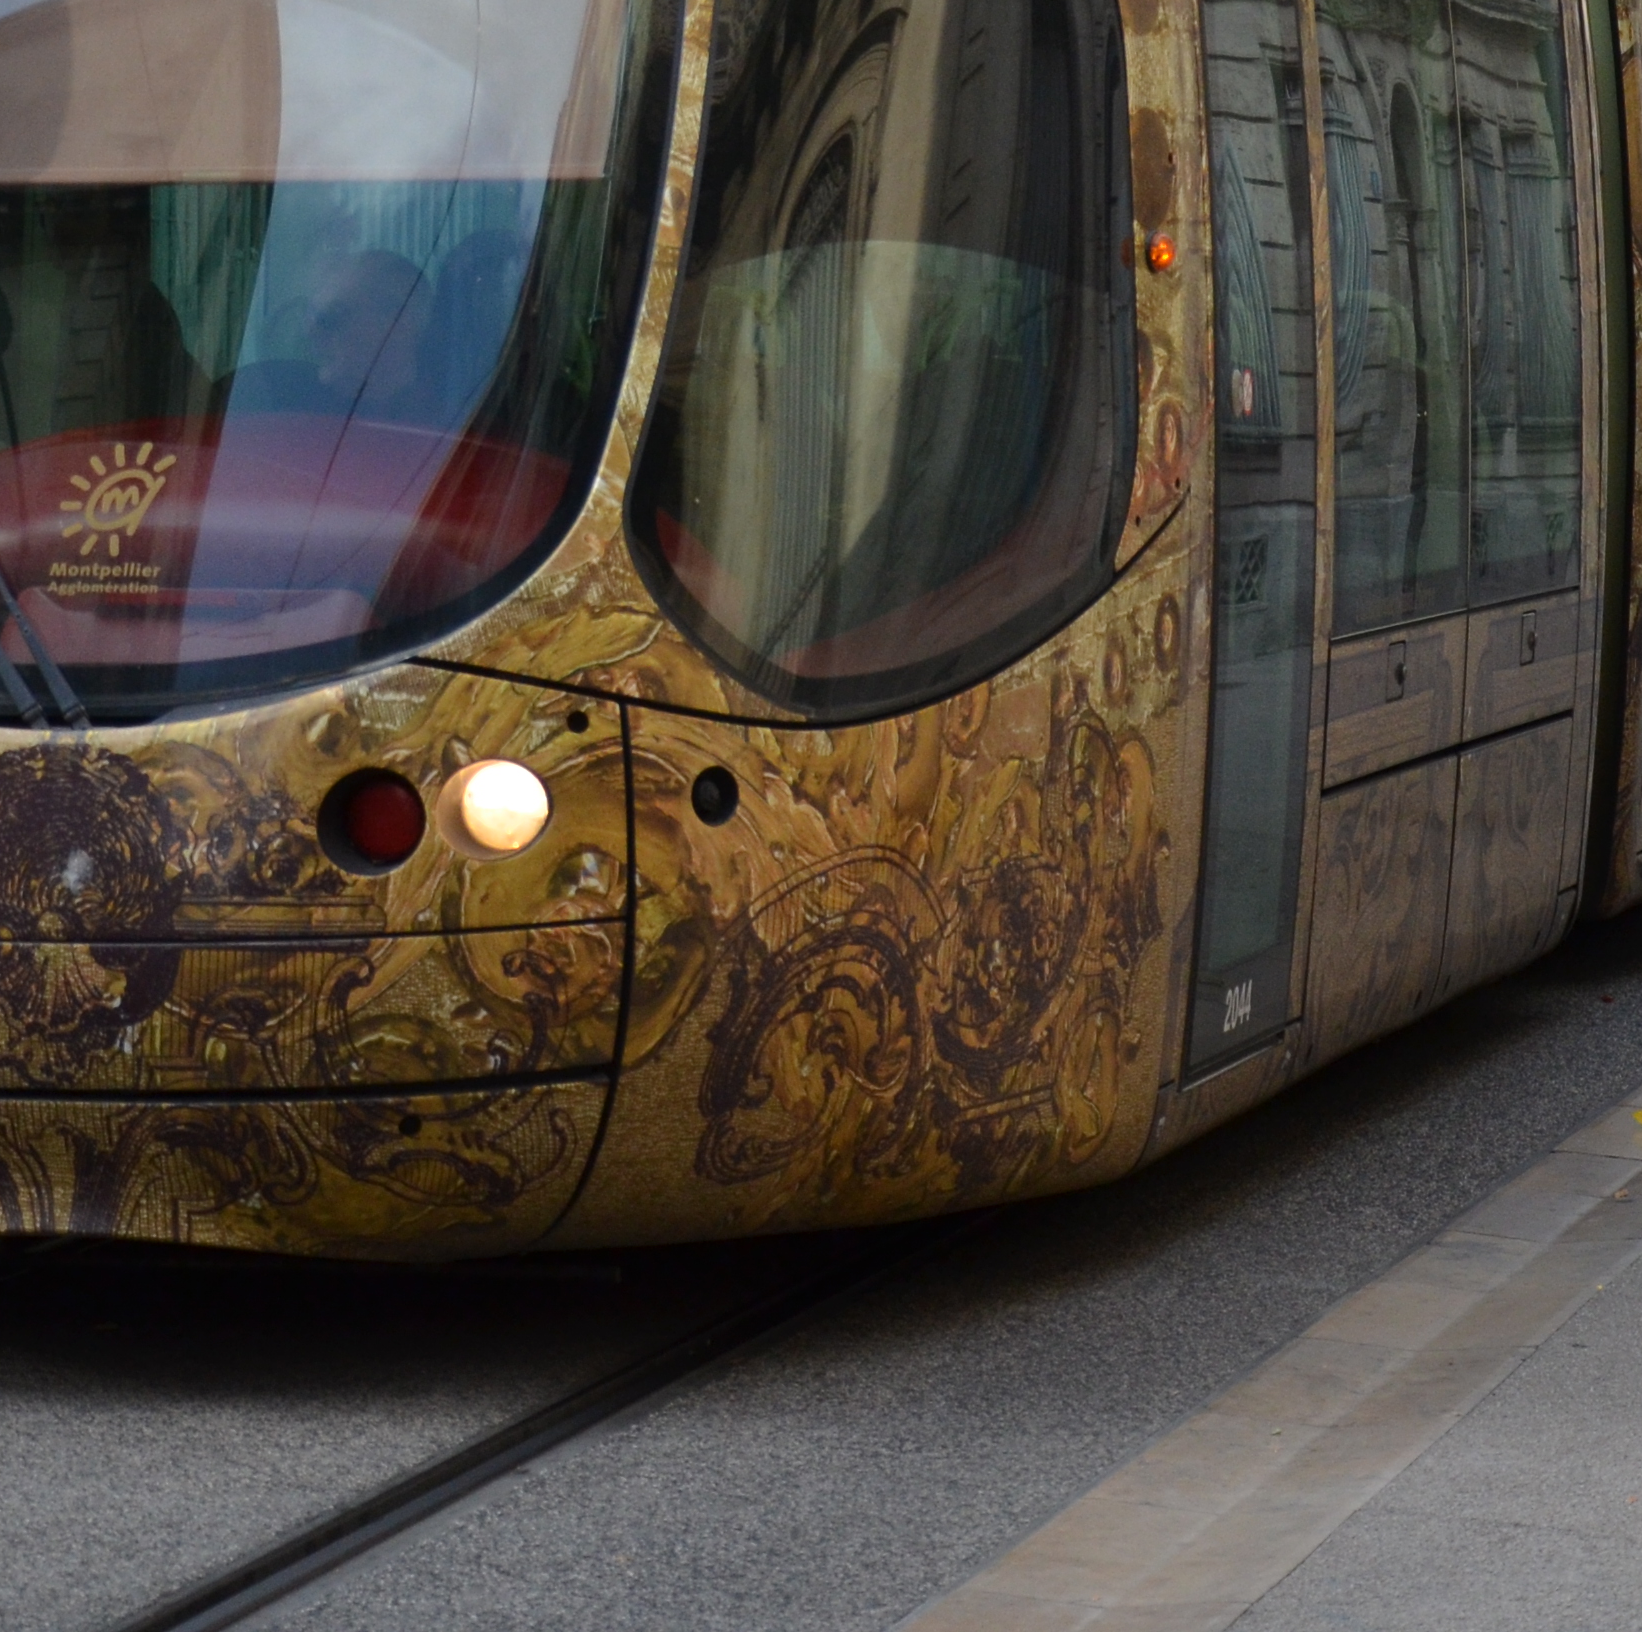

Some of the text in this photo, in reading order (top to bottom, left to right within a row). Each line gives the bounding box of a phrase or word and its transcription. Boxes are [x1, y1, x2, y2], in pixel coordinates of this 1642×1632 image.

[49, 562, 161, 581] Montpellier
[47, 580, 159, 596] Agglomération
[1223, 979, 1253, 1032] 2044
